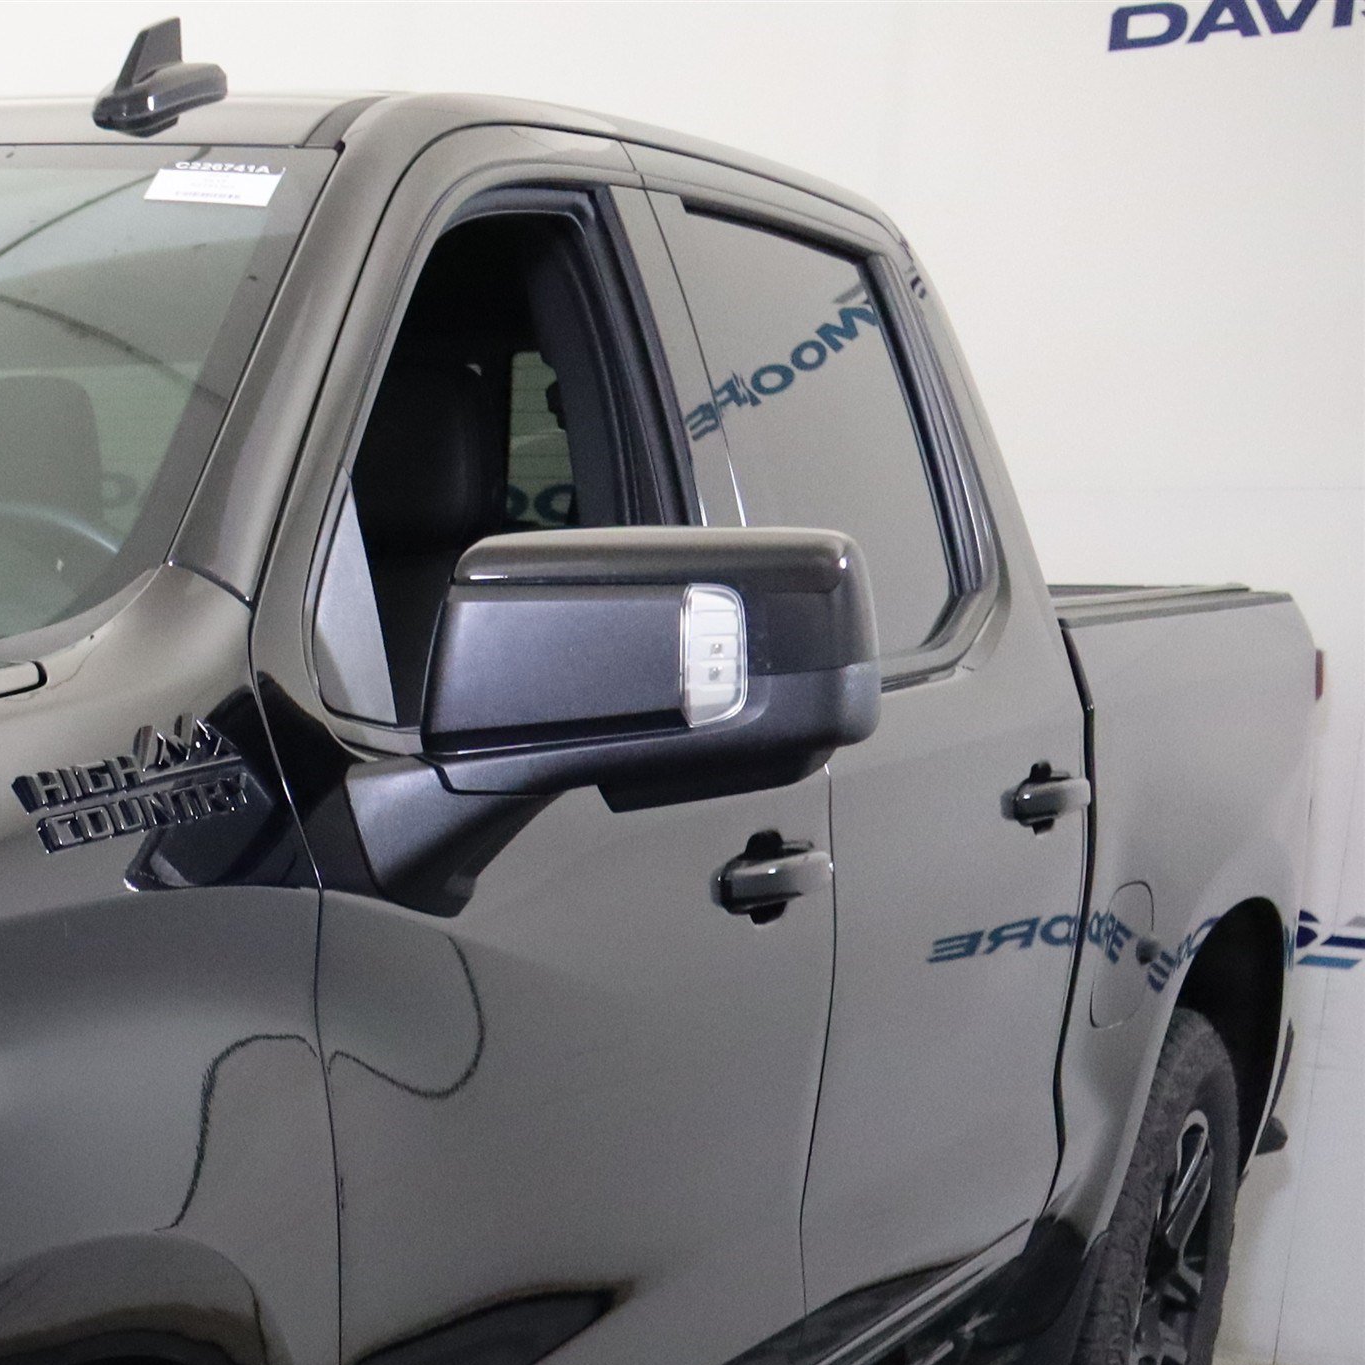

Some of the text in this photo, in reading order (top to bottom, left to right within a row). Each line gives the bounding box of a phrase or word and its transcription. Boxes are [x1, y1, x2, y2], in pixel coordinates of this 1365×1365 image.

[1108, 0, 1365, 51] DAVI
[12, 754, 145, 815] HIGH
[36, 772, 248, 854] COUNTRY
